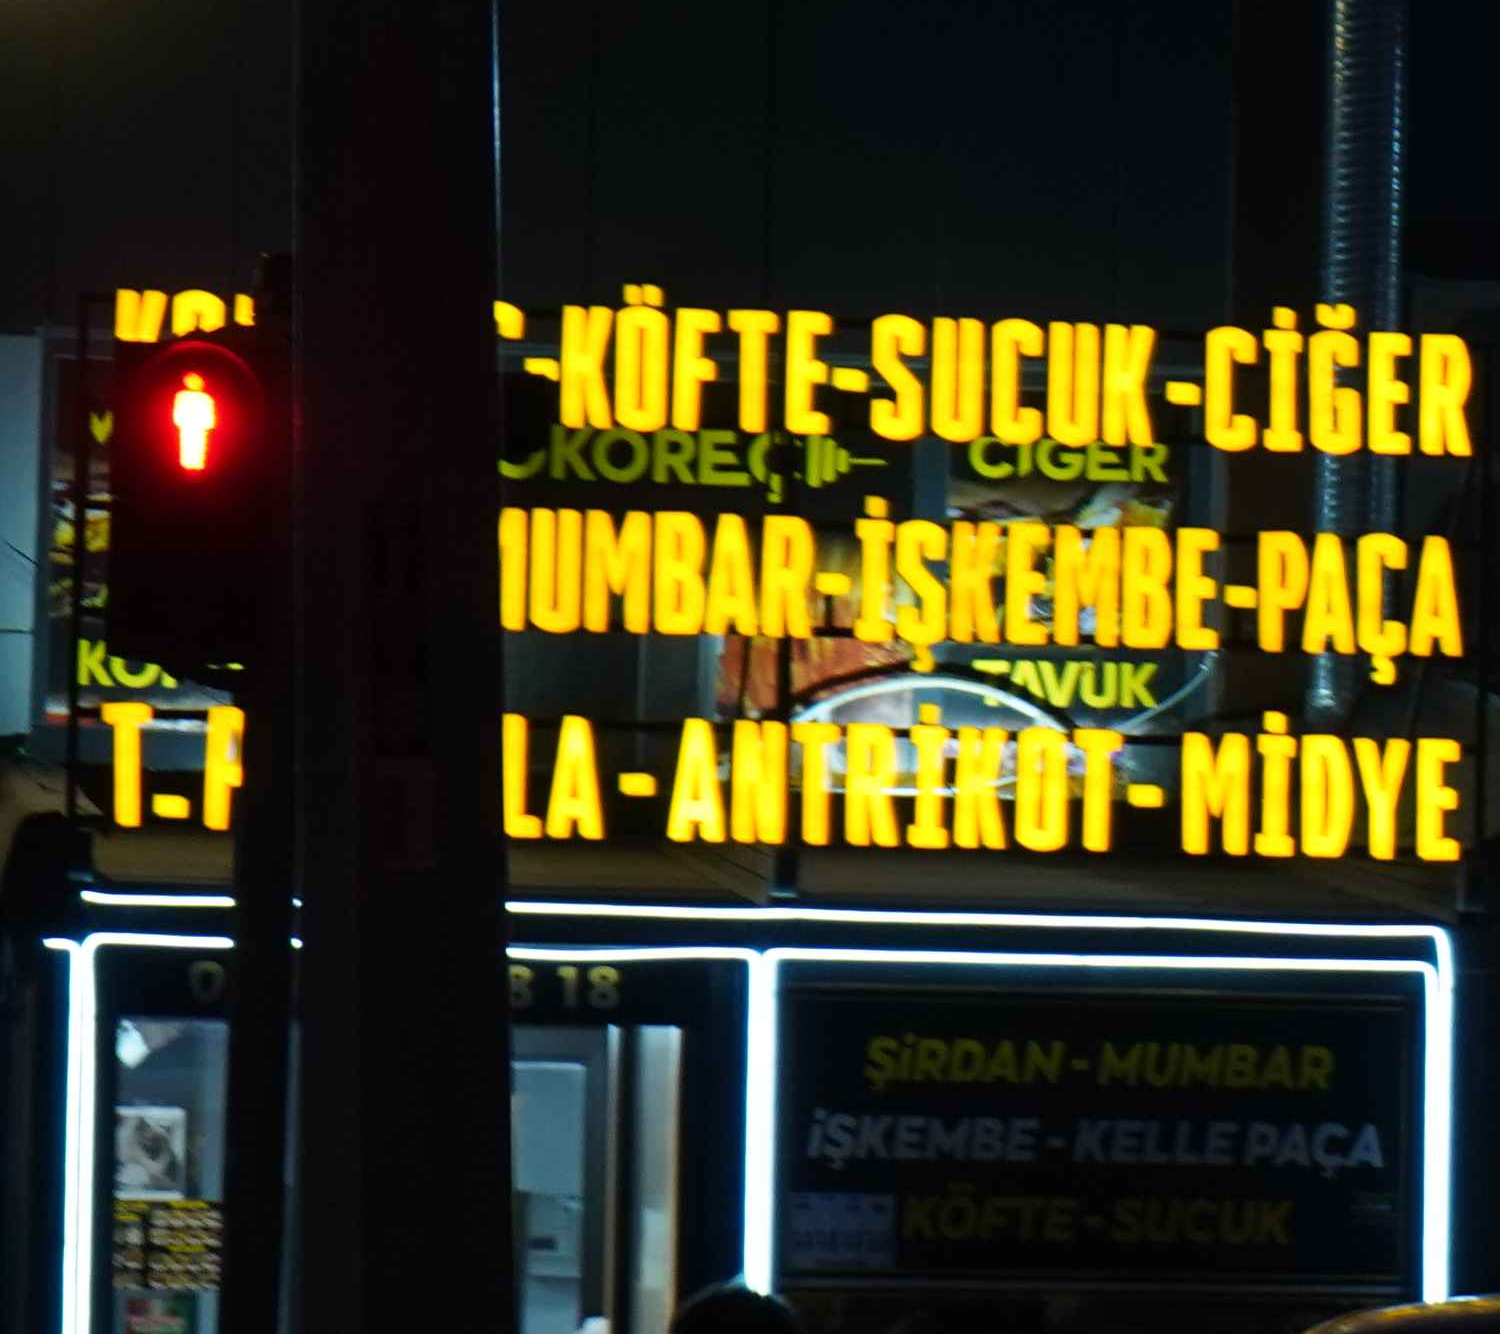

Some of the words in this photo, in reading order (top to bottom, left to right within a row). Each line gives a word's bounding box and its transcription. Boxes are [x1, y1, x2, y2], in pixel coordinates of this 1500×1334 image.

[1097, 1043, 1336, 1091] MUMBAR
[1072, 1117, 1237, 1166] KELLE
[1241, 1122, 1387, 1178] PAÇA
[902, 1181, 1075, 1240] KÖFTE
[1110, 1197, 1297, 1245] SUCUK
